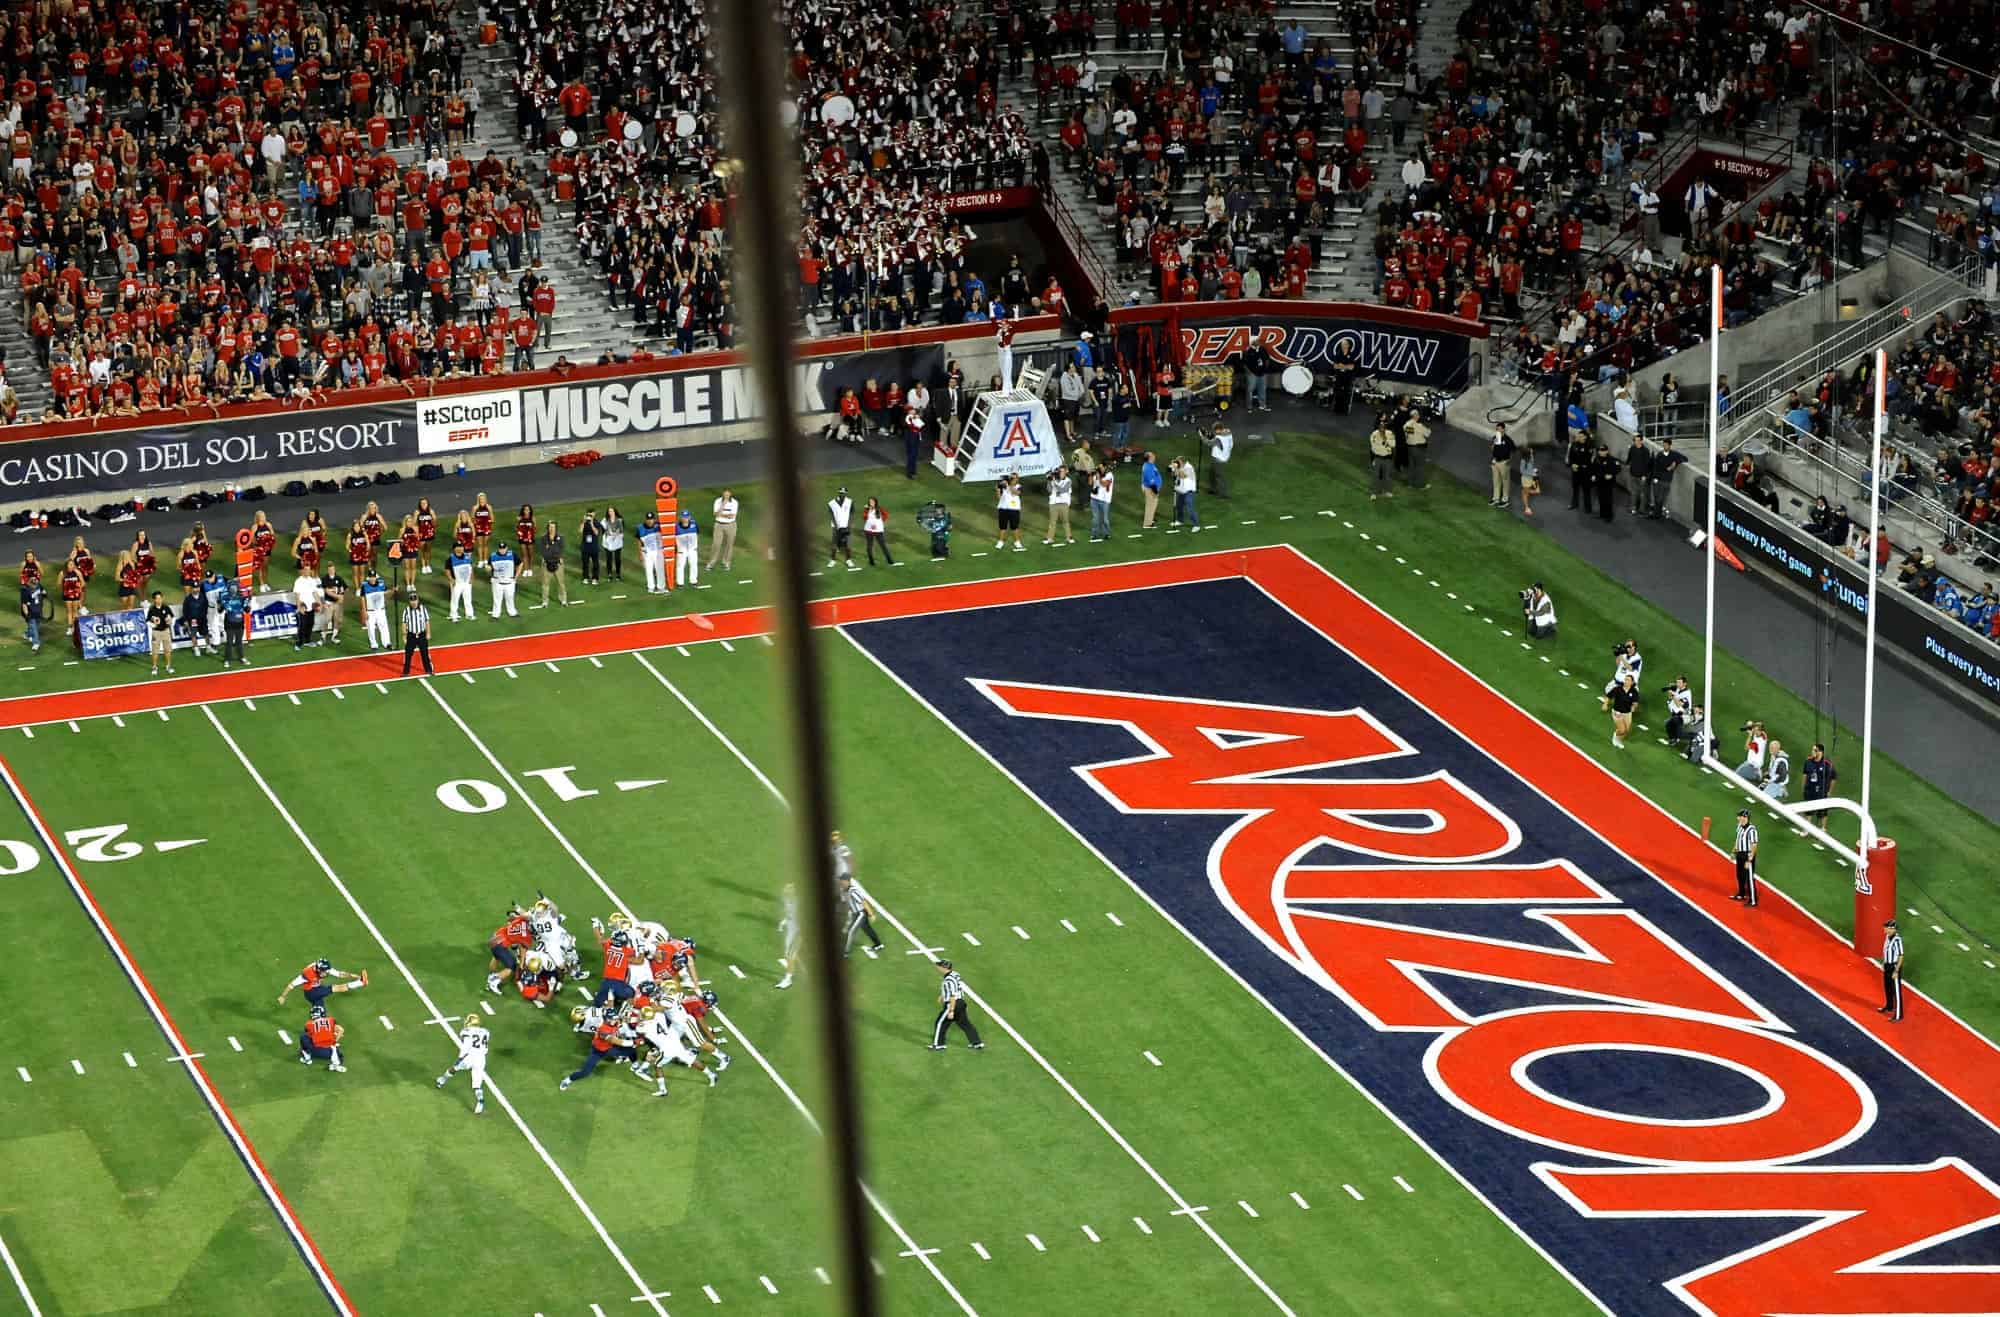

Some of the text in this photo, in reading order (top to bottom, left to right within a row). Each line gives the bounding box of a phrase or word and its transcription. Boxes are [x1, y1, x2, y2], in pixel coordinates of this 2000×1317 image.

[956, 193, 988, 207] SECTION
[1177, 326, 1440, 377] BEAR DOWN
[523, 362, 826, 443] MUSCLE MK
[423, 399, 512, 426] #SCtop10
[448, 427, 489, 443] ESPN
[993, 410, 1041, 459] A
[0, 420, 402, 486] CASINO DEL SOL RESORT
[1717, 511, 1813, 578] Plus every Pac-12 game
[92, 621, 136, 636] Game
[253, 612, 297, 629] LOWE
[85, 632, 145, 651] Sponsor
[1925, 636, 2000, 693] Plus every Pac-1
[607, 950, 624, 969] 77
[656, 1022, 668, 1036] 4
[472, 1033, 488, 1049] 24
